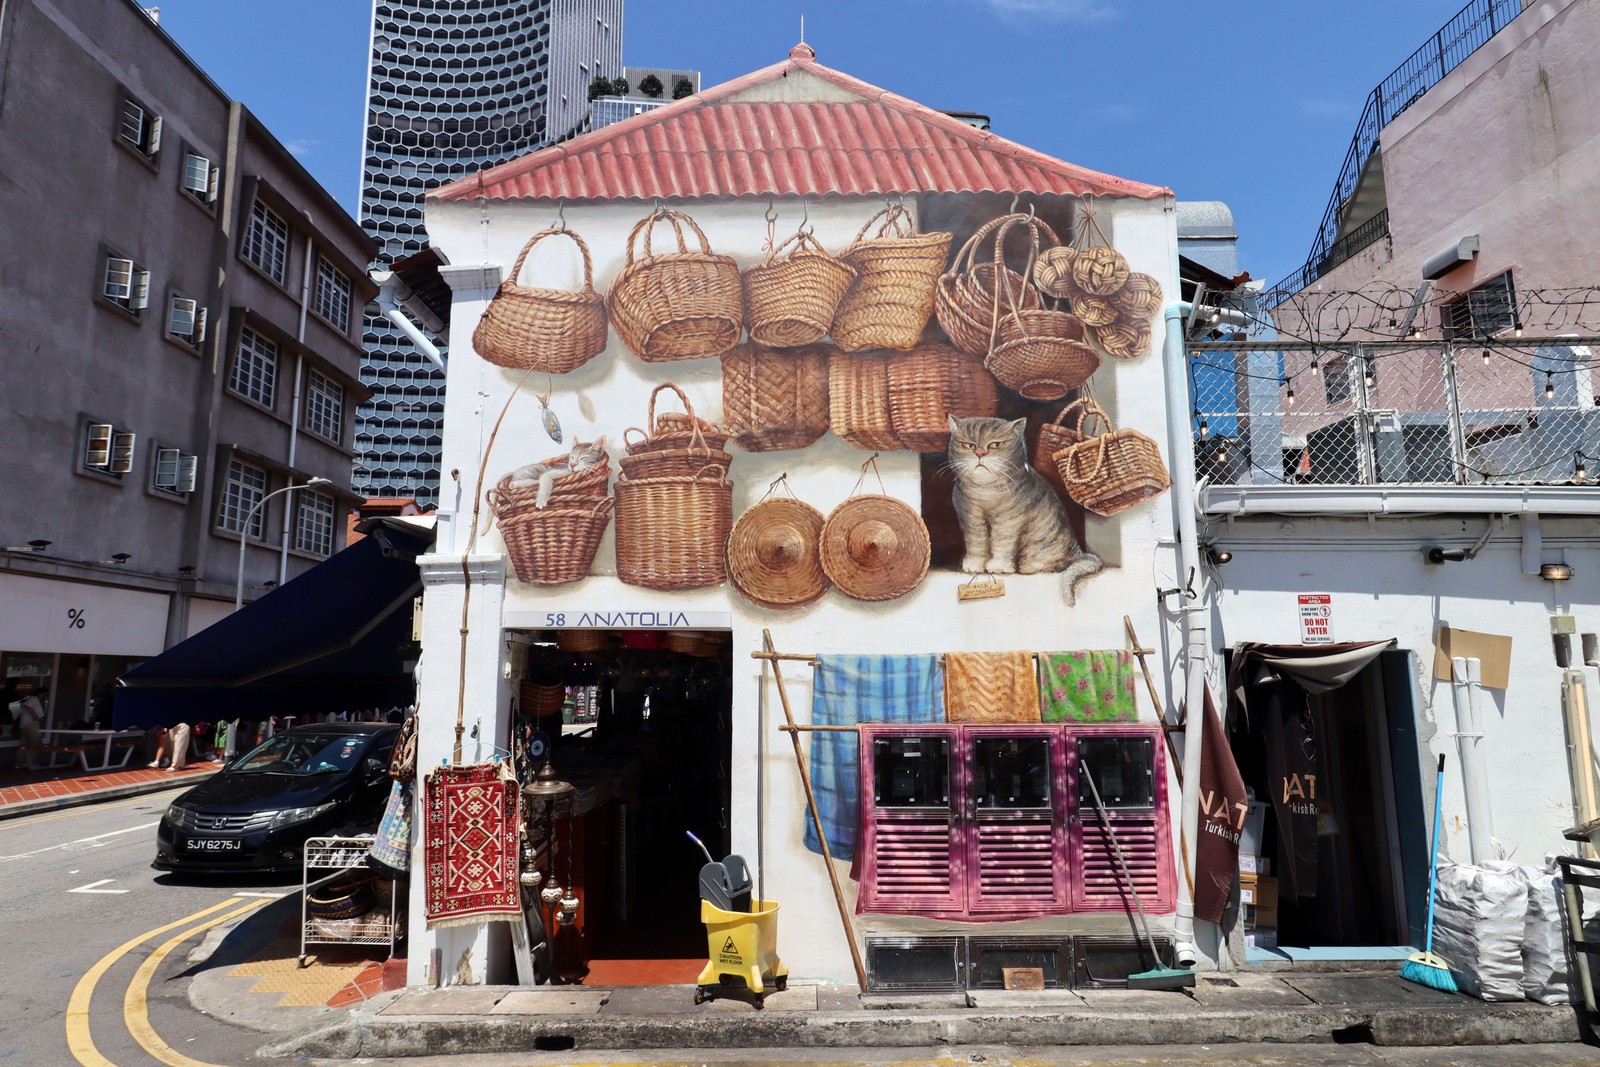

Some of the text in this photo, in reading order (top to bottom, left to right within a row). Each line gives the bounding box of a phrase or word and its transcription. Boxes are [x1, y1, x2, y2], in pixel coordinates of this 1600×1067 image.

[546, 612, 690, 626] 58 ANATOLIA
[1304, 618, 1328, 626] DO NOT
[1307, 627, 1328, 635] ENTER
[1204, 819, 1233, 842] Turkish
[187, 840, 241, 850] SJY6275J
